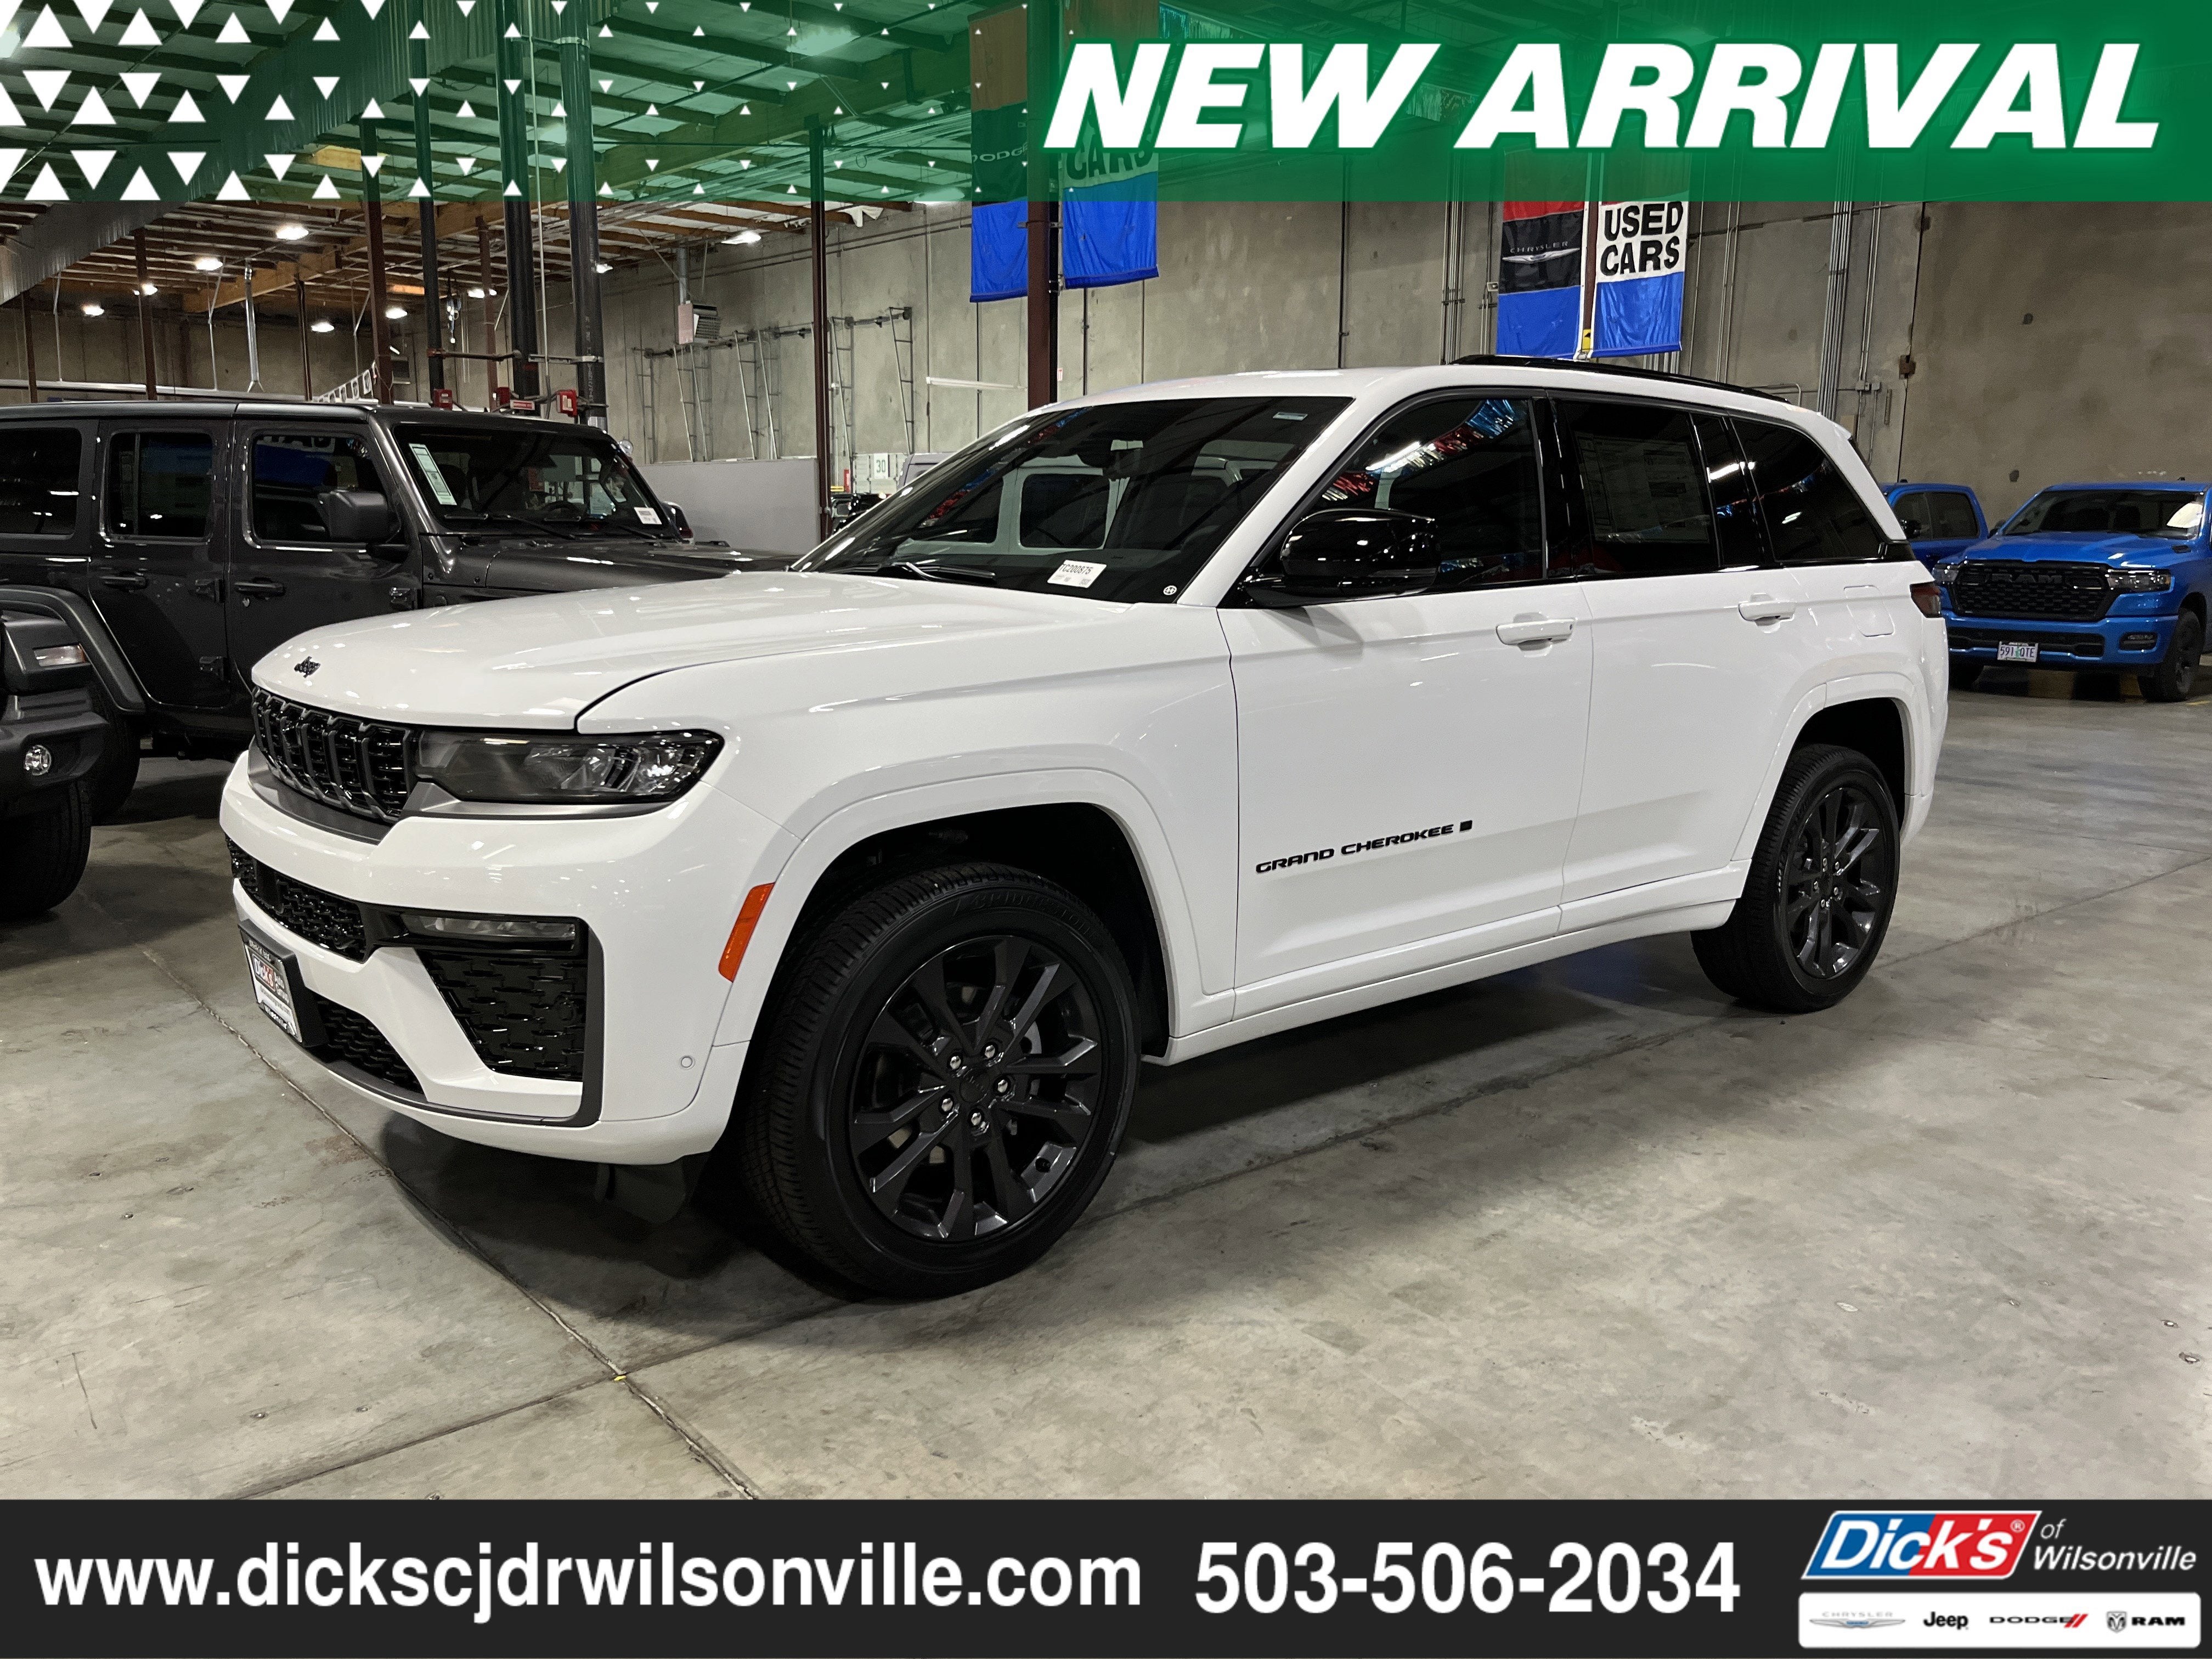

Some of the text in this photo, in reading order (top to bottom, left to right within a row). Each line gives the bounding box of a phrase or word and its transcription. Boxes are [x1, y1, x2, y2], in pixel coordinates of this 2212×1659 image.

[1604, 201, 1683, 241] USED
[1510, 241, 1568, 253] CHRYSLER
[1600, 236, 1679, 276] CARS
[876, 459, 885, 473] 30
[2000, 646, 2015, 657] 591
[1256, 824, 1454, 873] GRAND CHEROKEE
